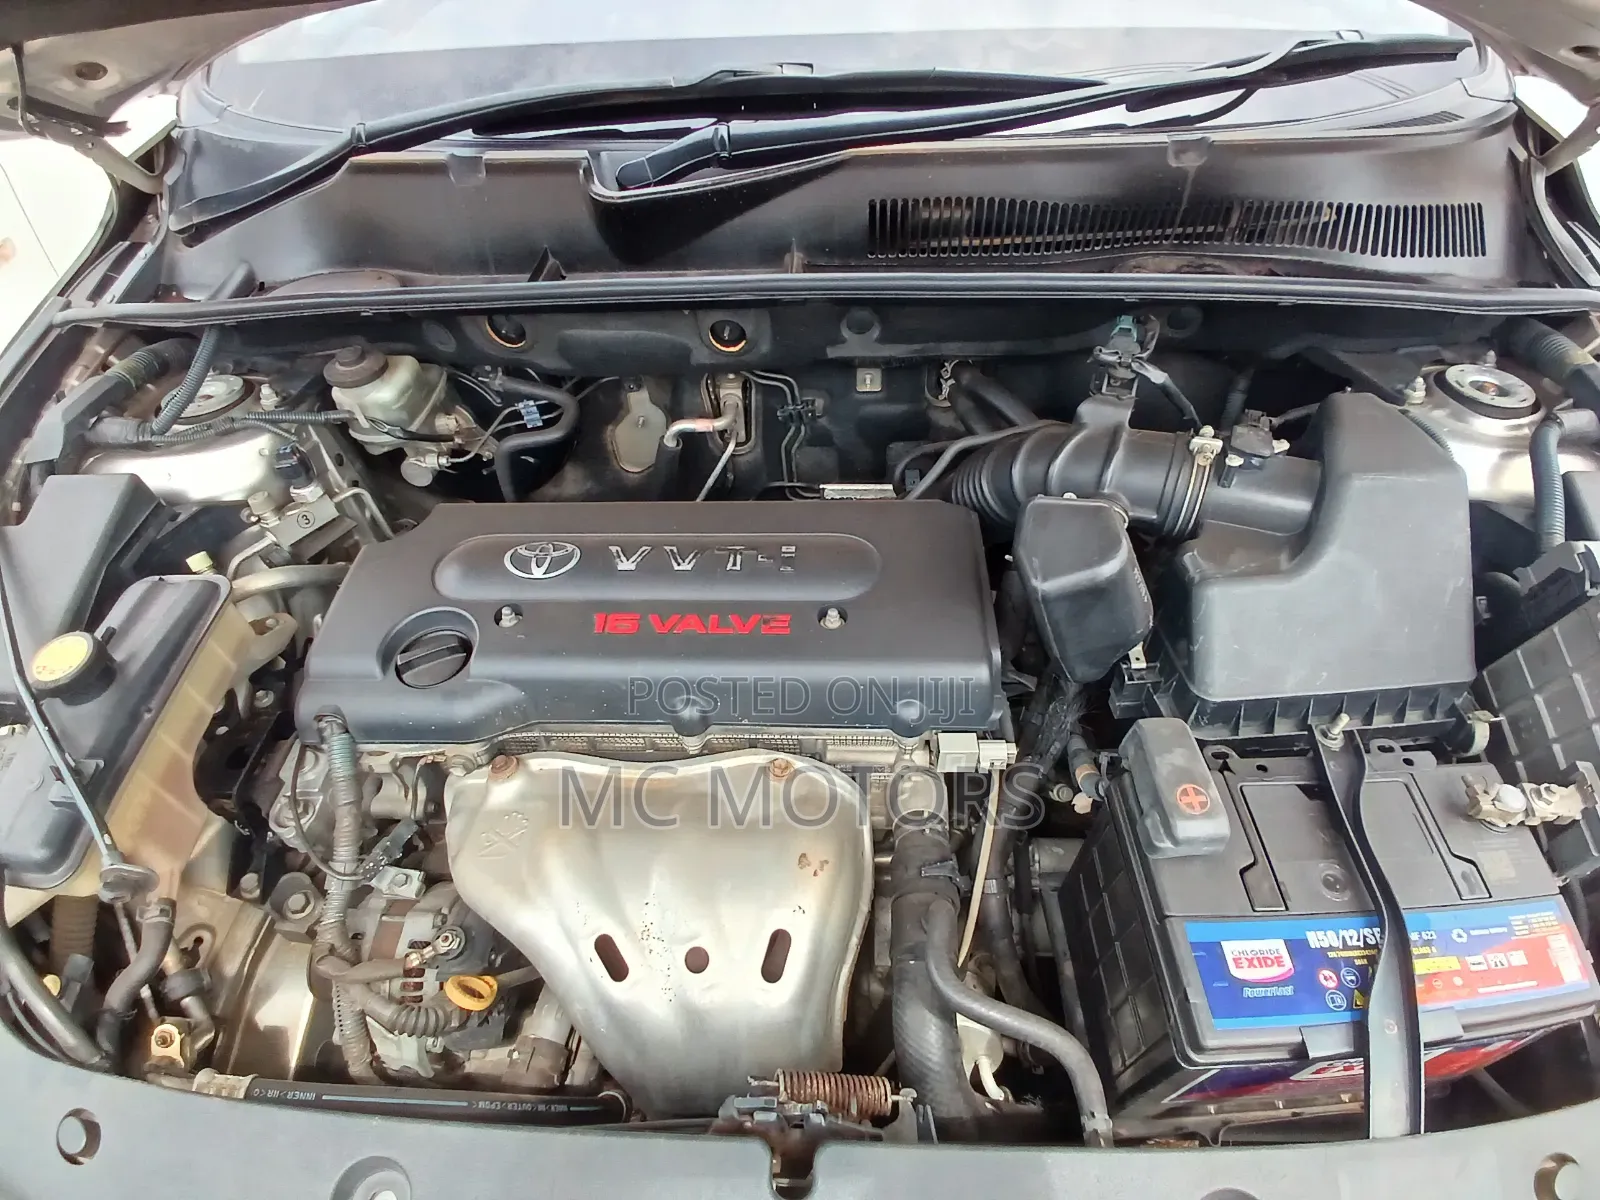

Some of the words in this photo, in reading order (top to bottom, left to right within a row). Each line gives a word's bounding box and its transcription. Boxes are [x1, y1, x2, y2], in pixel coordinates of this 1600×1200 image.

[608, 545, 797, 572] VVT-i
[593, 612, 639, 635] 16
[648, 612, 792, 635] VALVE
[1231, 948, 1281, 957] CHLORIDE
[1232, 956, 1286, 969] EXIDE
